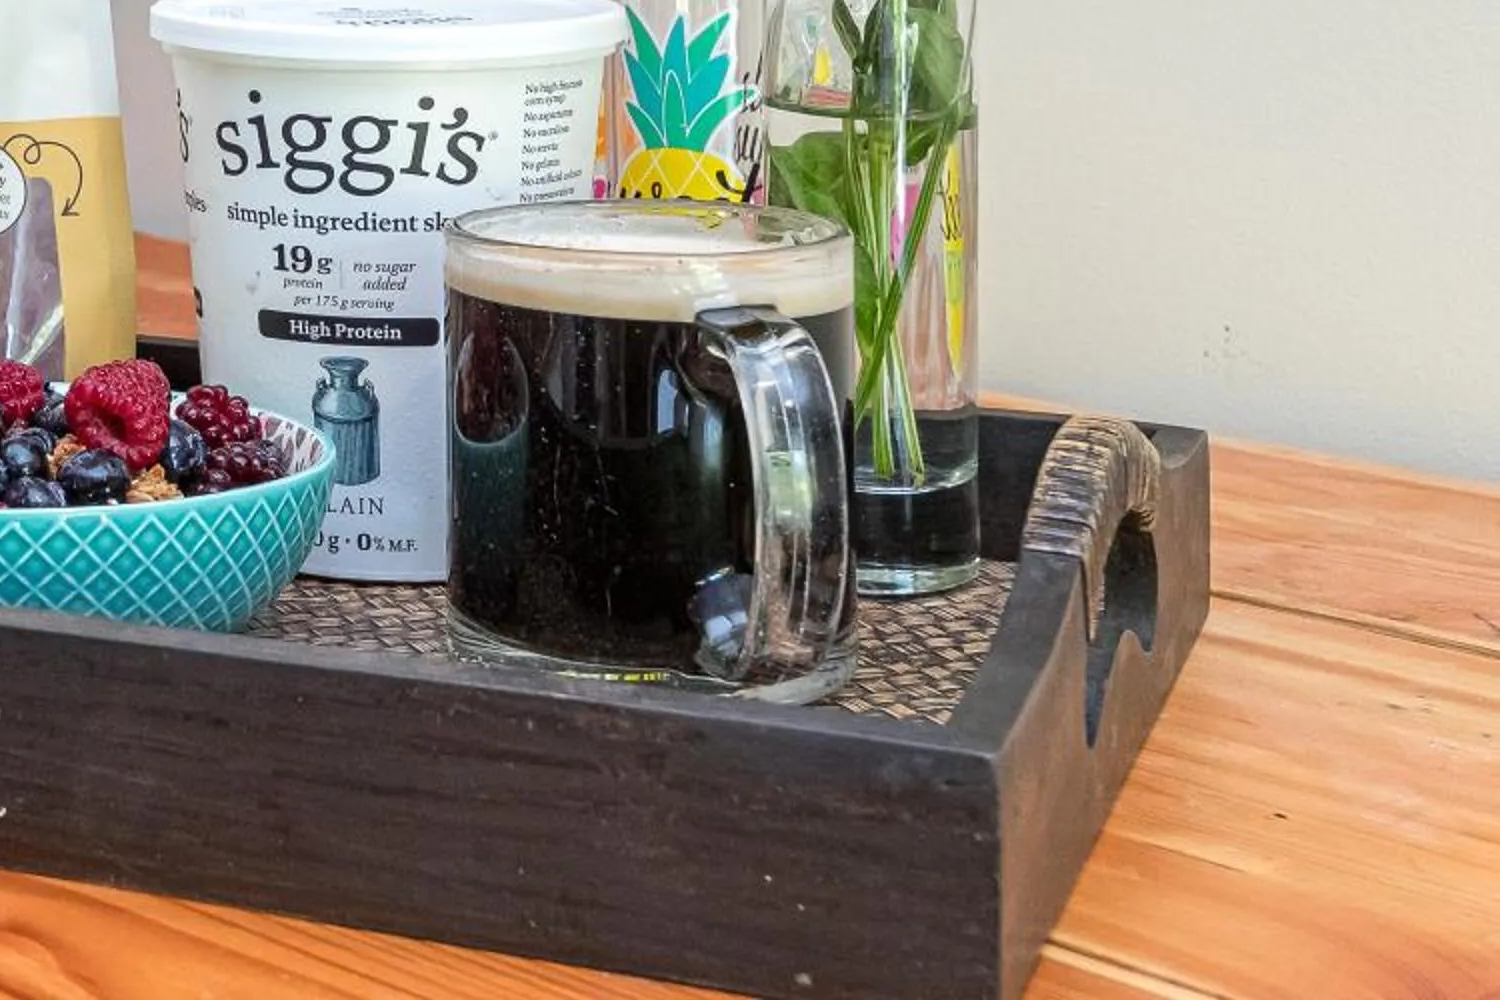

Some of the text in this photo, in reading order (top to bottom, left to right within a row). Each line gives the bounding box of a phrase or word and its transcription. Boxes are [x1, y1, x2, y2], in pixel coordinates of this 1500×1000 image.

[215, 89, 487, 197] siggi's
[227, 202, 450, 235] simple ingredient sk
[353, 261, 417, 277] no sugar
[283, 277, 323, 291] protein
[363, 276, 408, 291] added
[293, 294, 312, 307] per
[351, 297, 395, 312] serving
[289, 319, 402, 341] High Protein
[324, 496, 384, 514] LAIN
